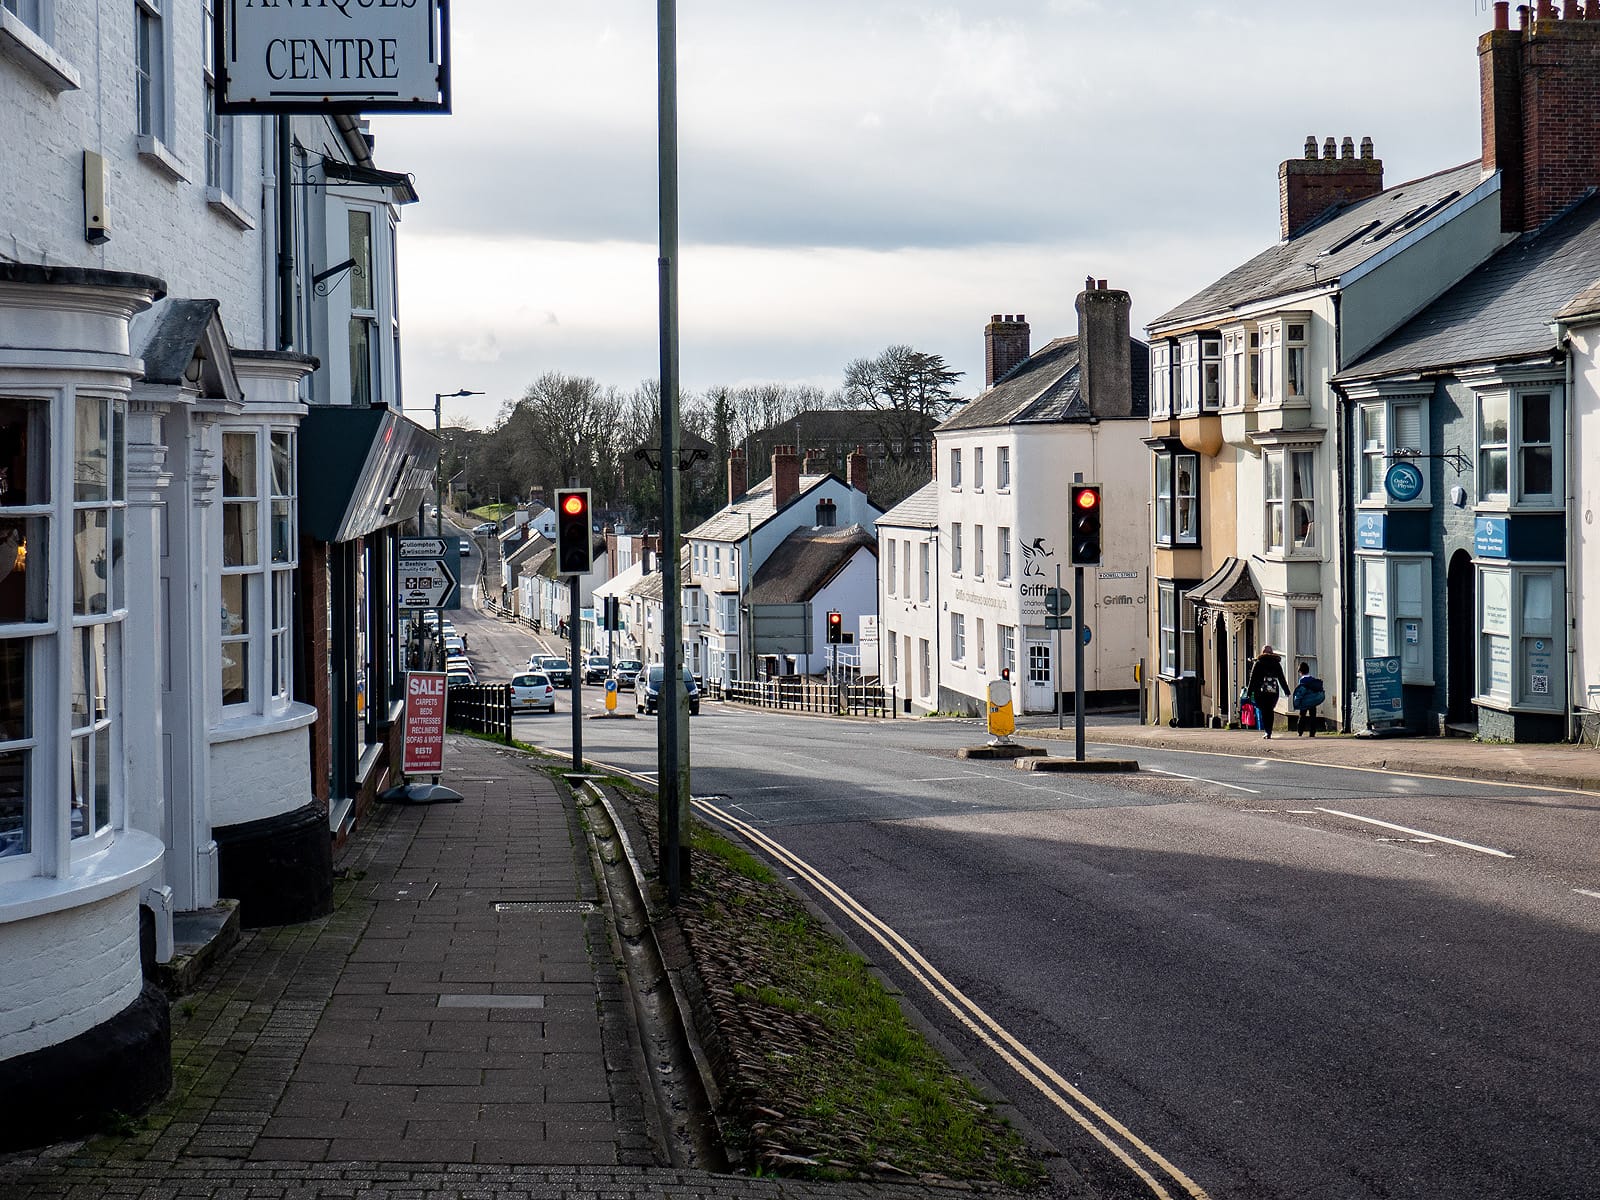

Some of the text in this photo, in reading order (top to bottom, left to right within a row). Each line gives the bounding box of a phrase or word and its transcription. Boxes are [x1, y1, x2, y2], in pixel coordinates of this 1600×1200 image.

[265, 38, 399, 80] CENTRE
[1020, 584, 1053, 596] Griffi
[1103, 595, 1133, 605] Griffin
[410, 678, 443, 695] SALE
[415, 698, 438, 706] CARPETS
[420, 707, 433, 715] BEDS
[409, 717, 441, 725] MATTRESSES
[411, 726, 439, 734] RECLINERS
[406, 736, 423, 744] SOFAS
